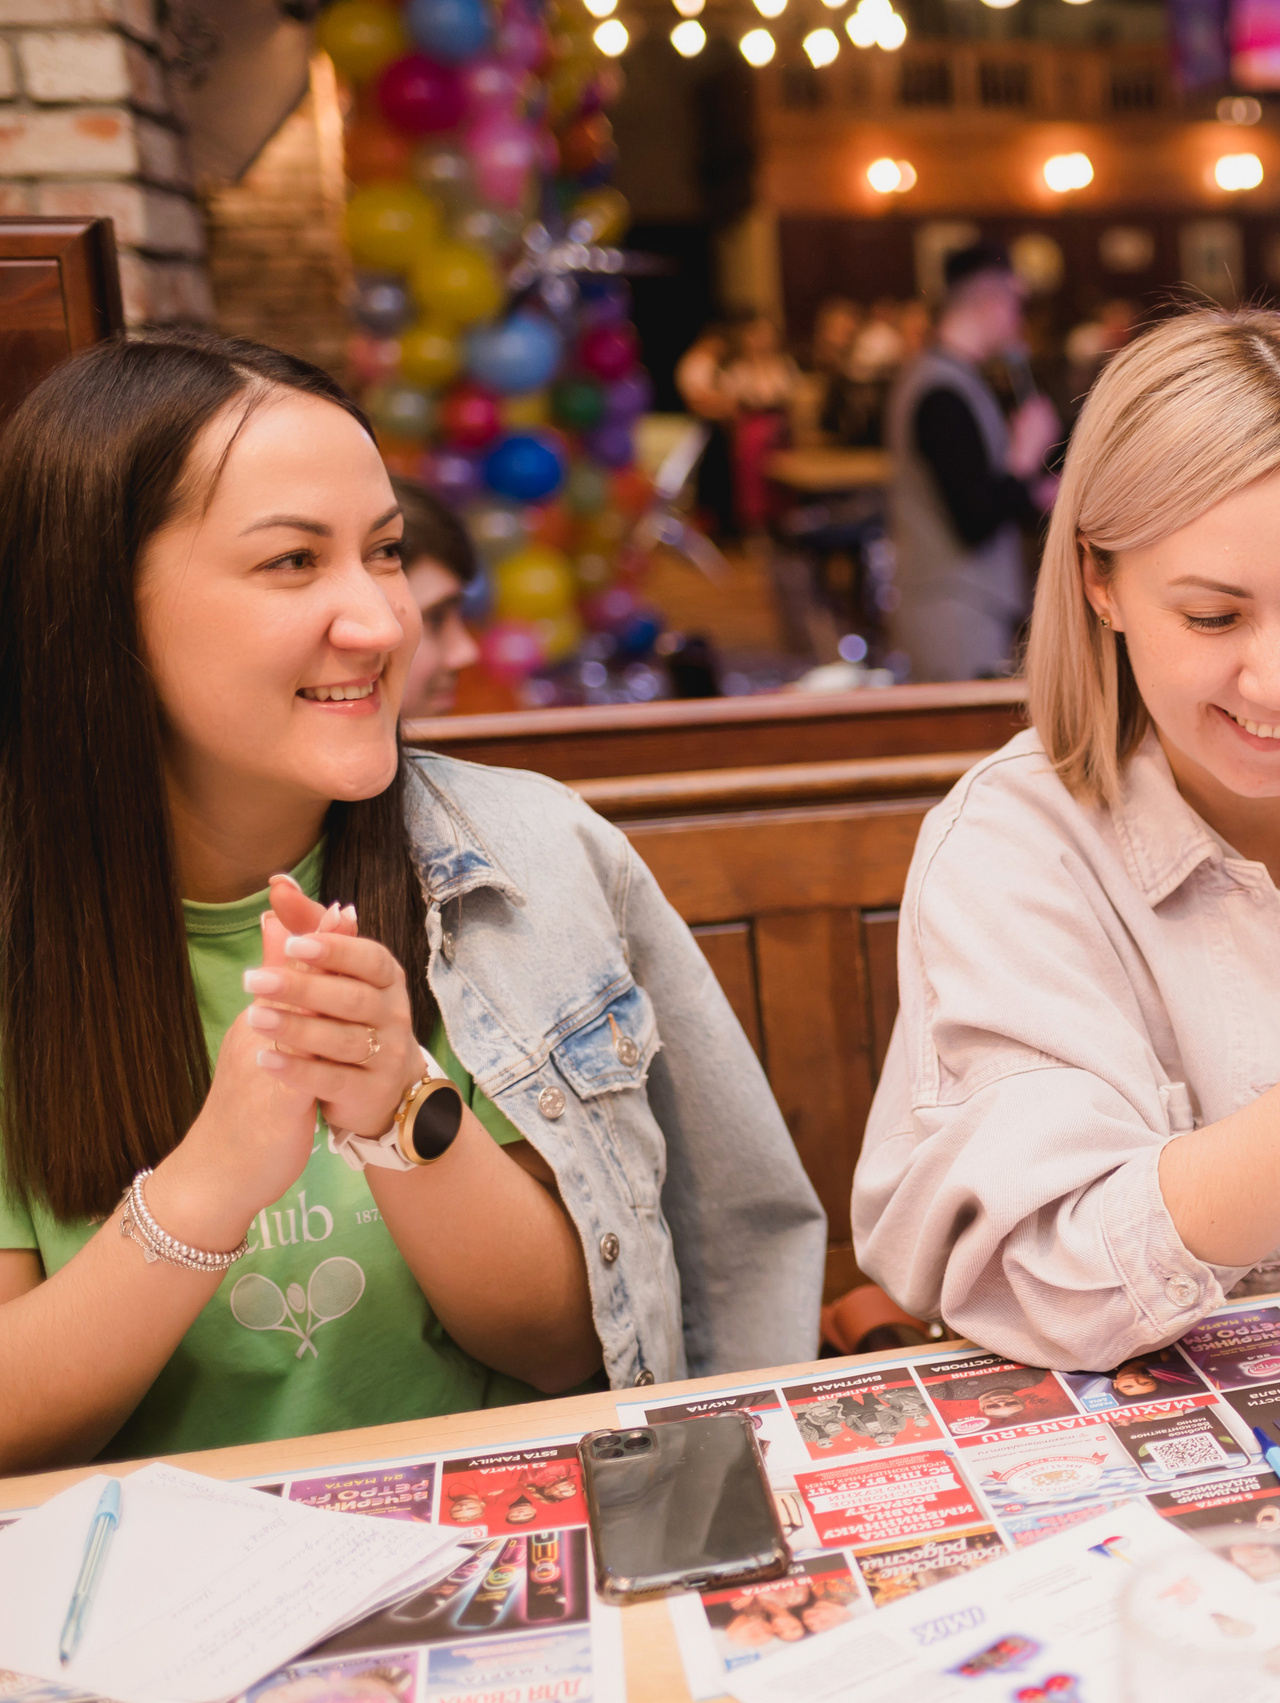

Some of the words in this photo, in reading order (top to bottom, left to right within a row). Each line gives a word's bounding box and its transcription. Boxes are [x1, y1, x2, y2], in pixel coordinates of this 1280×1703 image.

[1182, 1333, 1212, 1345] FM
[950, 1366, 1000, 1379] АПРЕЛЯ
[812, 1374, 882, 1393] БИРТМАН
[871, 1383, 887, 1392] 20
[816, 1387, 869, 1401] АПРЕЛЯ
[686, 1399, 737, 1412] АКУЛА
[981, 1399, 1196, 1443] MAXIMILIANS.RU
[1176, 1417, 1206, 1426] меню
[1130, 1421, 1210, 1440] бесконтактное
[1168, 1424, 1213, 1437] удобное
[468, 1454, 521, 1466] FAMILY
[532, 1461, 547, 1469] 23
[910, 1460, 947, 1470] КРОМЕ
[479, 1464, 528, 1474] МАРТА
[837, 1466, 909, 1484] КОНЦЕРТНЫХ
[889, 1468, 921, 1482] ПН,
[924, 1464, 951, 1476] ВС,
[325, 1477, 376, 1489] МАРТА
[383, 1473, 404, 1481] 24
[804, 1478, 835, 1489] ДНЕЙ
[861, 1475, 887, 1486] ВТ,
[337, 1480, 429, 1500] РЕТРО
[807, 1485, 833, 1496] ЧТ
[833, 1480, 860, 1491] СР,
[886, 1478, 938, 1491] МЕНЮ
[1170, 1477, 1259, 1498] ЖДАМИРОВ
[828, 1488, 882, 1502] КУХНИ
[830, 1488, 917, 1508] ОСНОВНОЕ
[1177, 1484, 1261, 1504] ВЛАДИМИР
[844, 1493, 938, 1517] ВОЗРАСТУ
[1195, 1495, 1241, 1508] МАРТА
[862, 1503, 926, 1522] РАВНА
[823, 1504, 974, 1540] ИМЕНИННИКУ
[858, 1519, 945, 1540] СКИДКА
